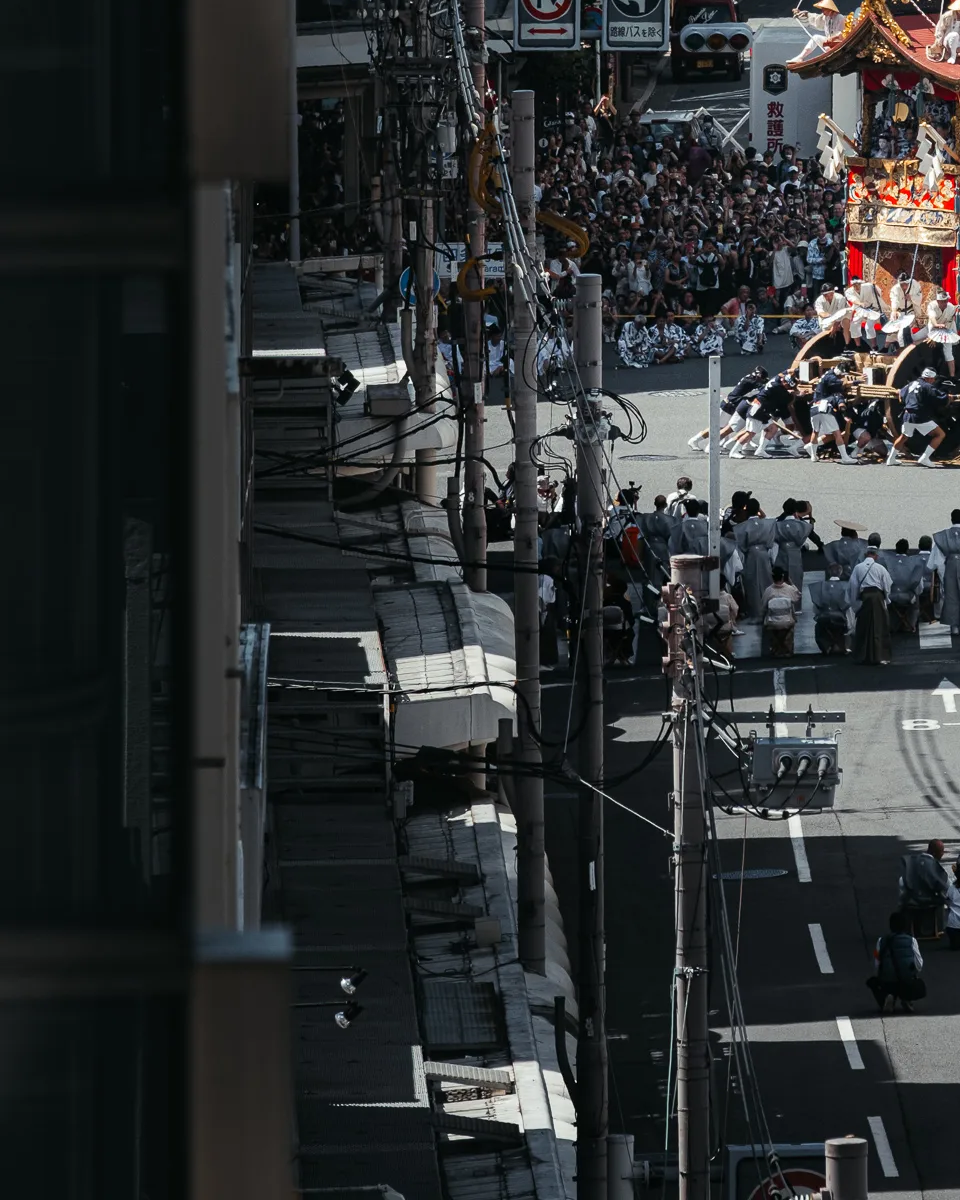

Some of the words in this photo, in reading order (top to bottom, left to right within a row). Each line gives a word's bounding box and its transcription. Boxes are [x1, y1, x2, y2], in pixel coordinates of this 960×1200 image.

[610, 25, 662, 38] 路線バスを除く
[766, 101, 784, 153] 救護所
